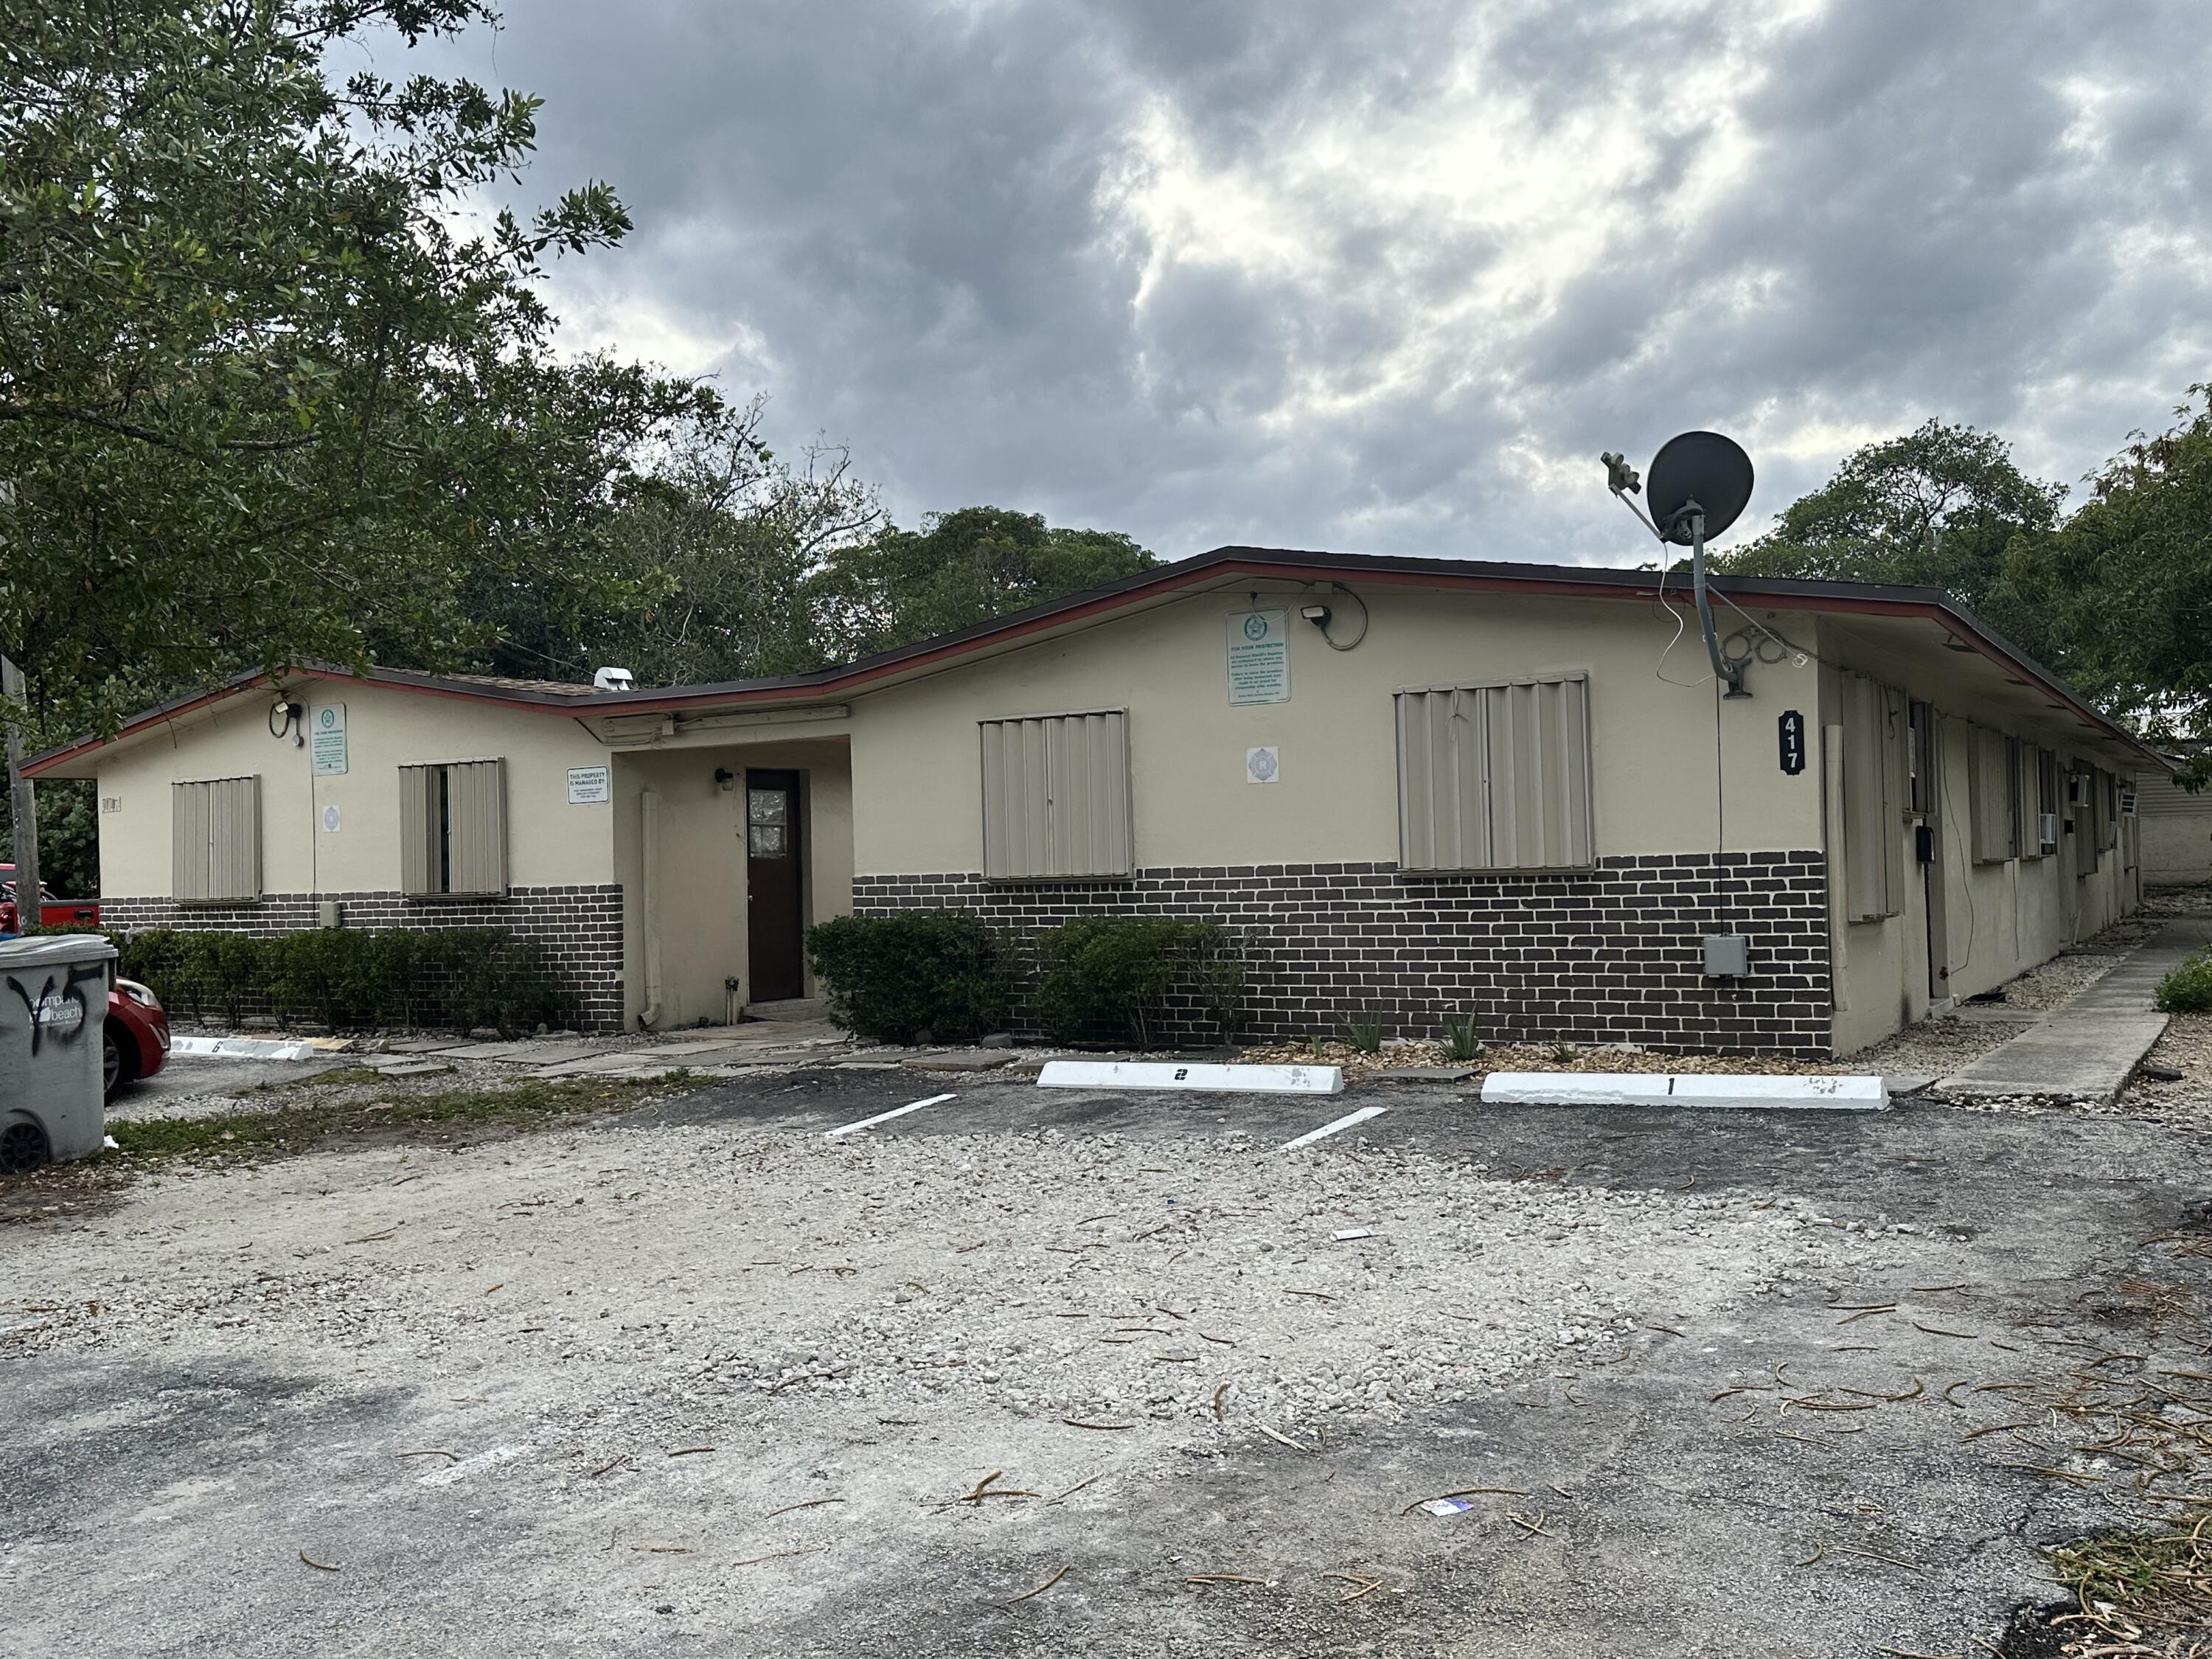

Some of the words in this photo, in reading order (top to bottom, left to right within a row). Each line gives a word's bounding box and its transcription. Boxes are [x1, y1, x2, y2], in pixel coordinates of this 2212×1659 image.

[1785, 717, 1798, 768] 417
[51, 1005, 82, 1020] beach
[1175, 1068, 1188, 1080] 2
[1668, 1077, 1674, 1095] 1
